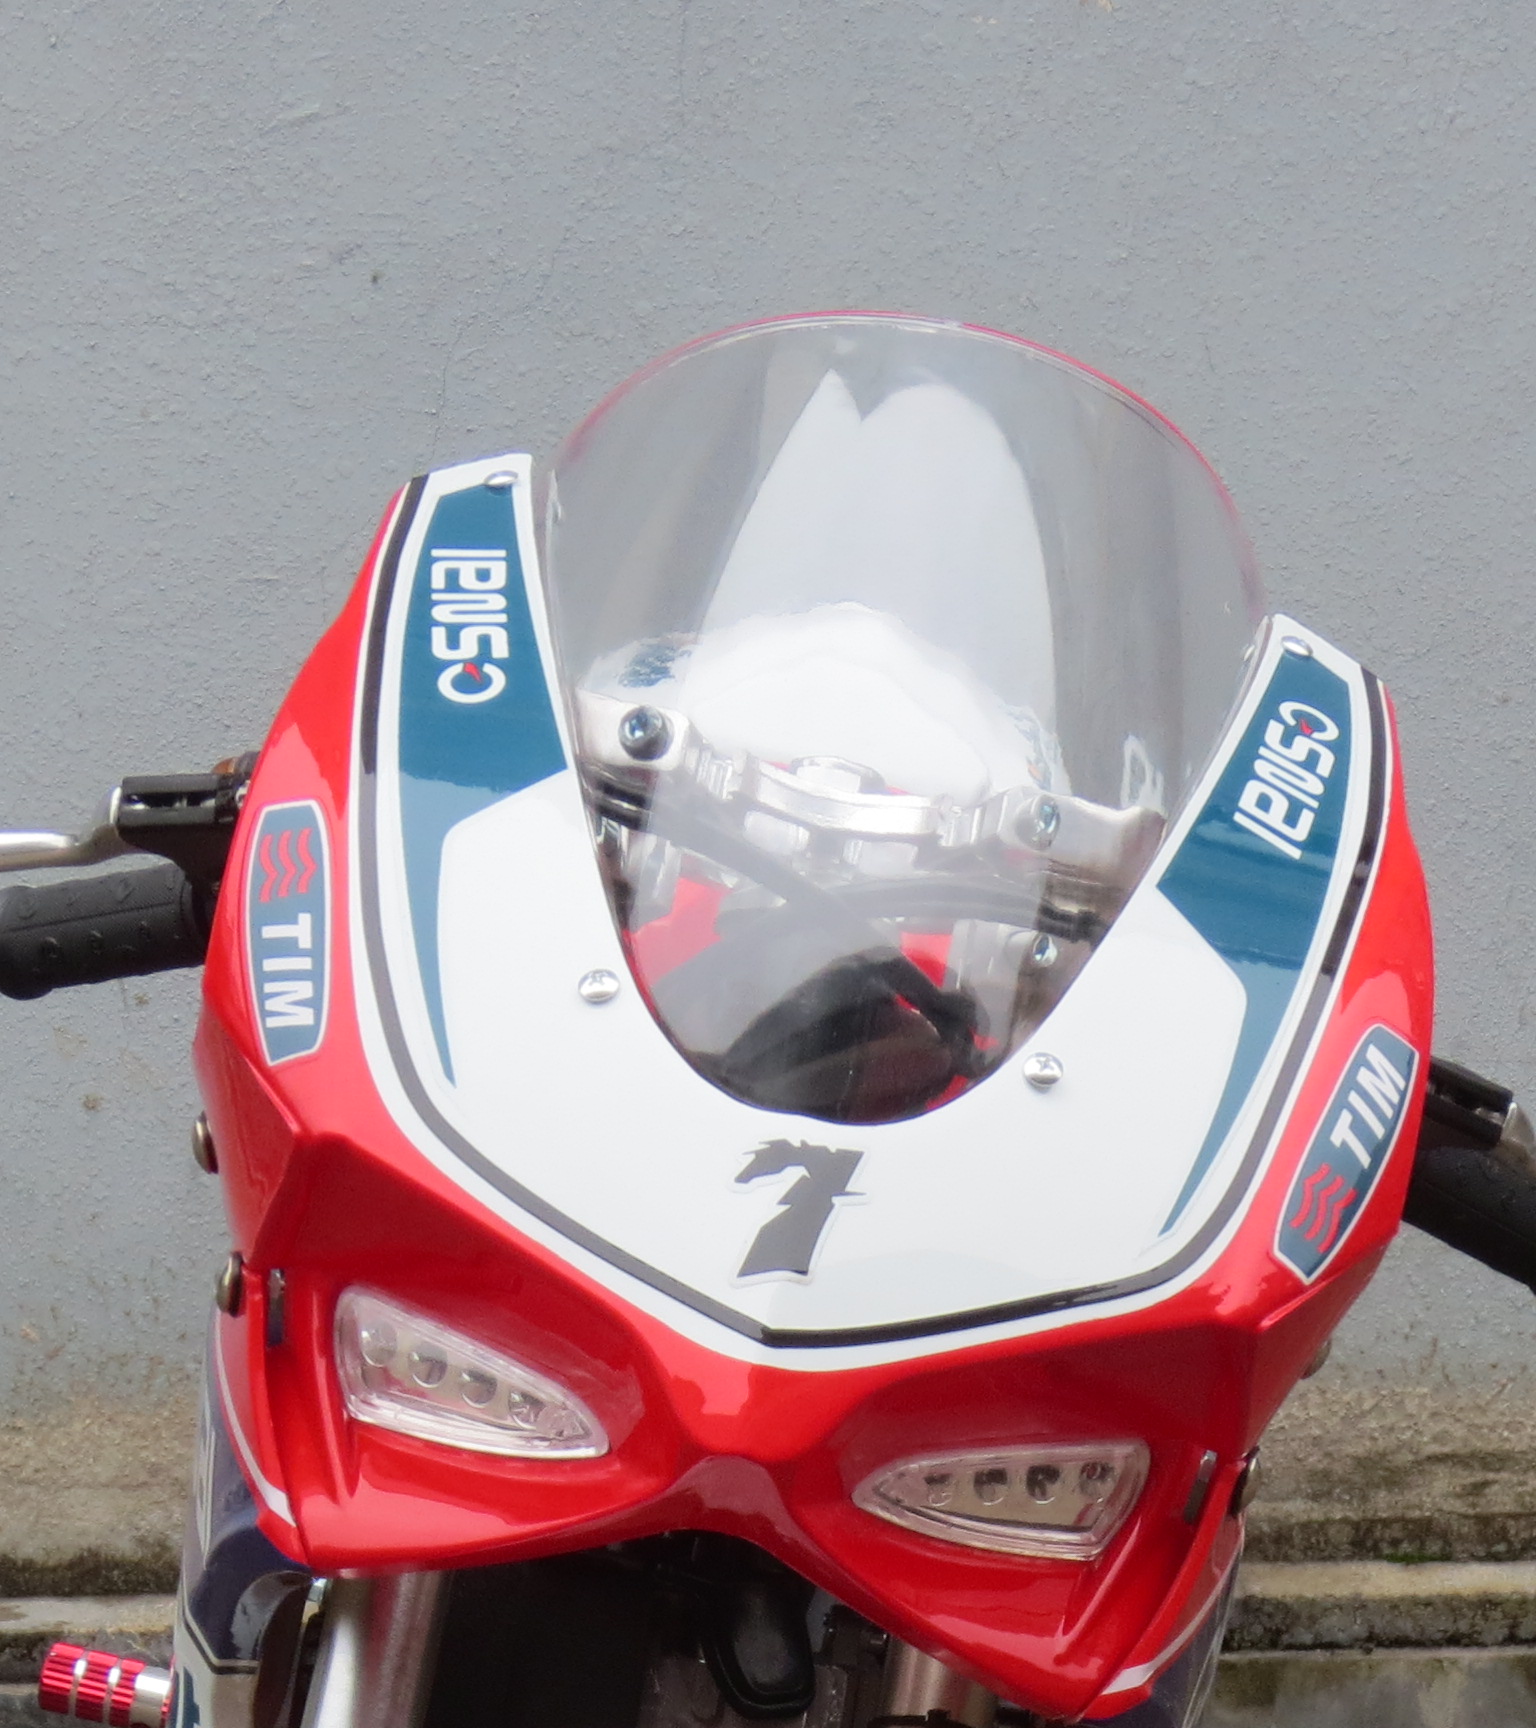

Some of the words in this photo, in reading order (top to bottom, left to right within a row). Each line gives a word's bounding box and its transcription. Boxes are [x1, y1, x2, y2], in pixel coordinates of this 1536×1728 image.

[261, 912, 314, 1028] TIM
[1331, 1044, 1406, 1169] TIM
[734, 1139, 867, 1278] 7
